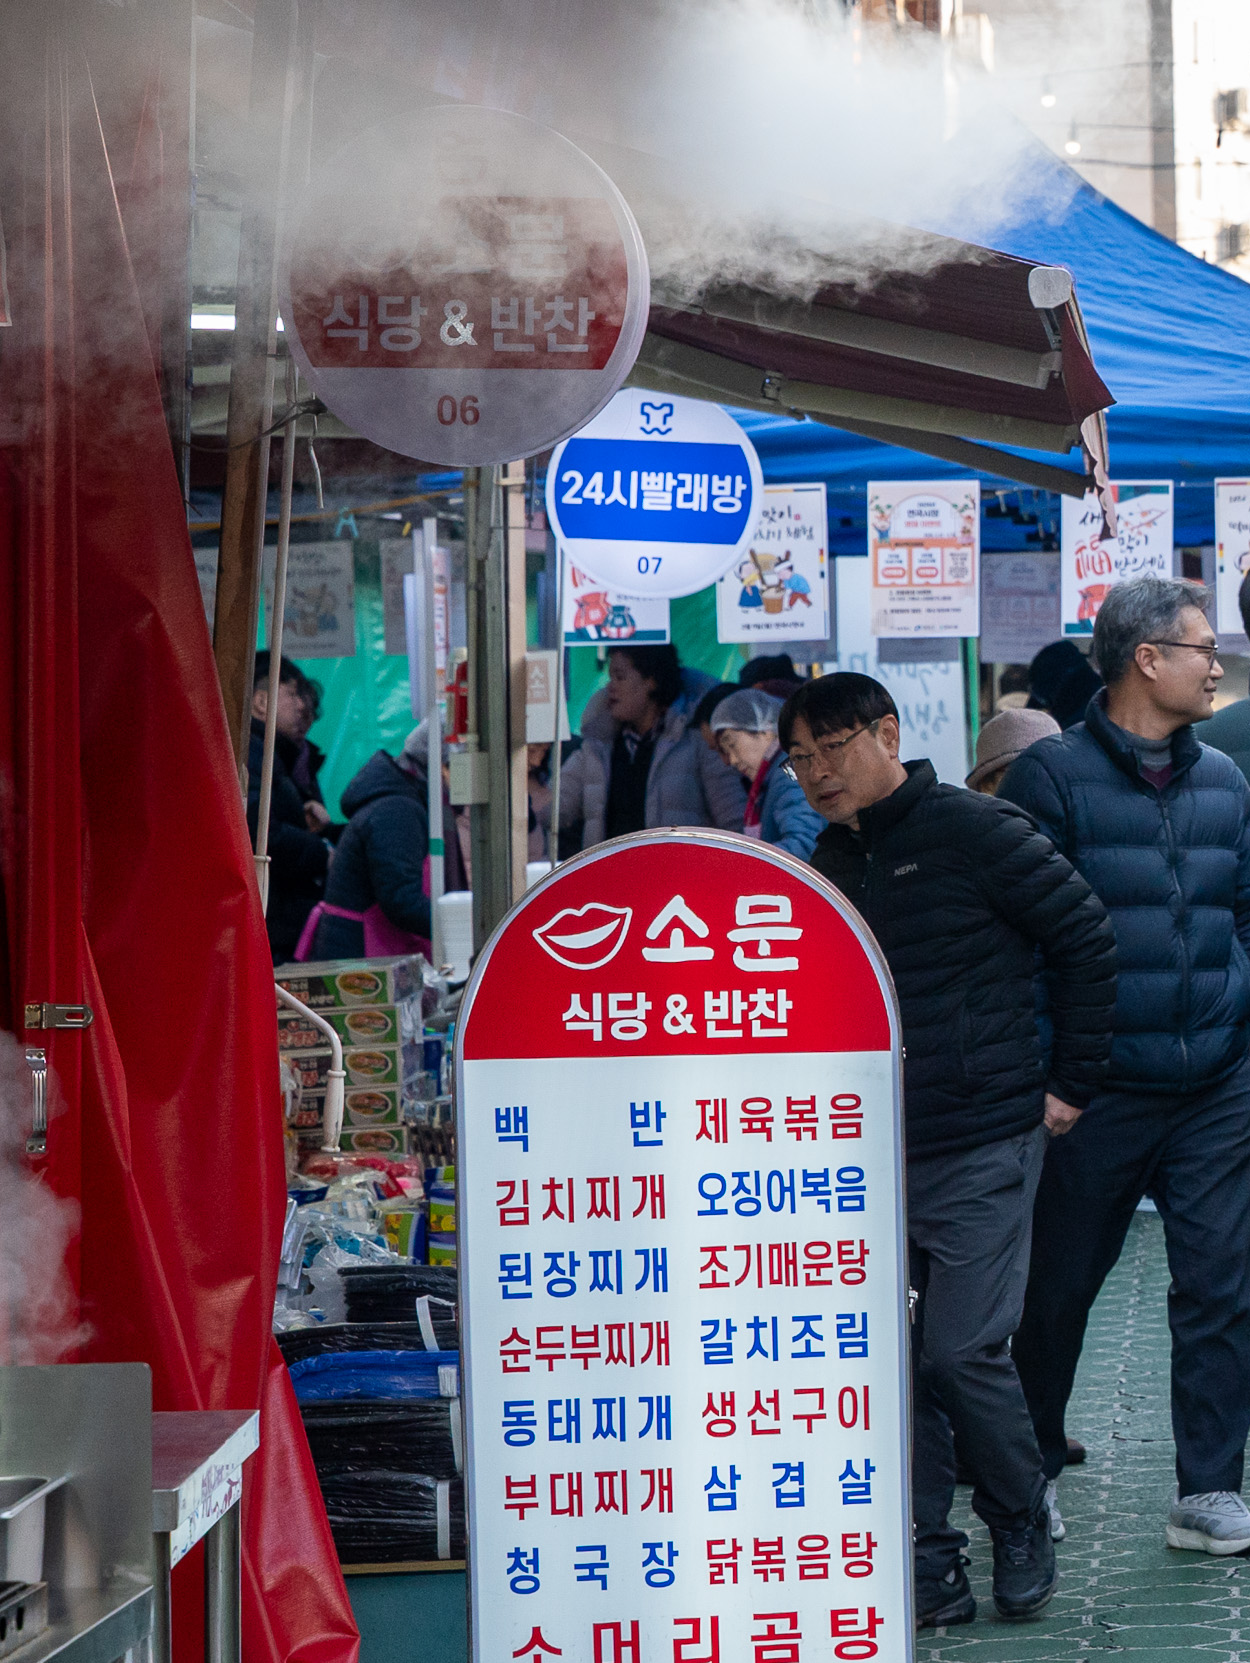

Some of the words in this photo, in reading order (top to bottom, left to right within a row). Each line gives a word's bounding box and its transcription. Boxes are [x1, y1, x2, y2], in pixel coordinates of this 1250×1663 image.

[322, 296, 427, 352] 식당
[440, 299, 478, 346] &
[491, 296, 595, 352] 반찬
[437, 395, 480, 426] 06
[561, 469, 747, 514] 24시빨래방
[761, 504, 792, 524] 맞이
[637, 556, 662, 575] 07
[642, 894, 804, 973] 소문
[562, 992, 653, 1042] 식당
[662, 993, 697, 1035] &
[704, 988, 793, 1039] 반찬
[695, 1093, 864, 1144] 제육볶음
[496, 1174, 666, 1227] 김치찌개
[498, 1247, 669, 1300] 된장찌개
[698, 1239, 870, 1290] 조기매운탕
[499, 1320, 670, 1374] 순두부찌개
[700, 1311, 869, 1365] 갈치조림
[501, 1394, 672, 1448] 동태찌개
[702, 1385, 870, 1438] 생선구이
[504, 1467, 673, 1521] 부대찌개
[705, 1532, 878, 1586] 닭볶음탕
